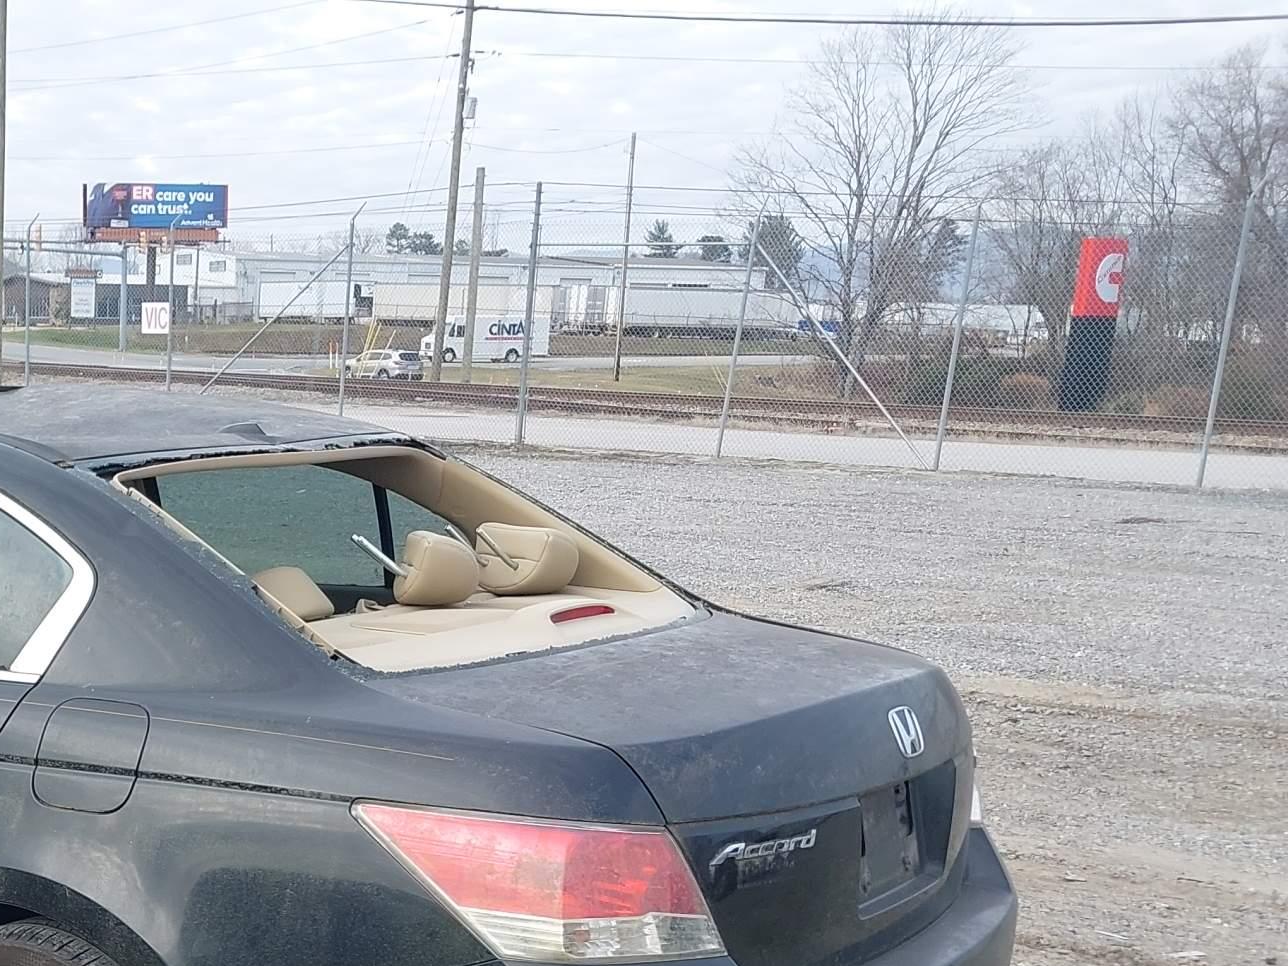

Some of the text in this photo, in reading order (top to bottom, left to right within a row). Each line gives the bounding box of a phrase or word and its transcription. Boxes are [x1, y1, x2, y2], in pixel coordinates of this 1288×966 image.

[132, 186, 214, 204] ER care you
[131, 202, 192, 215] can trust.
[145, 306, 168, 330] VIC
[488, 319, 526, 336] CINTA
[709, 829, 816, 866] Accord
